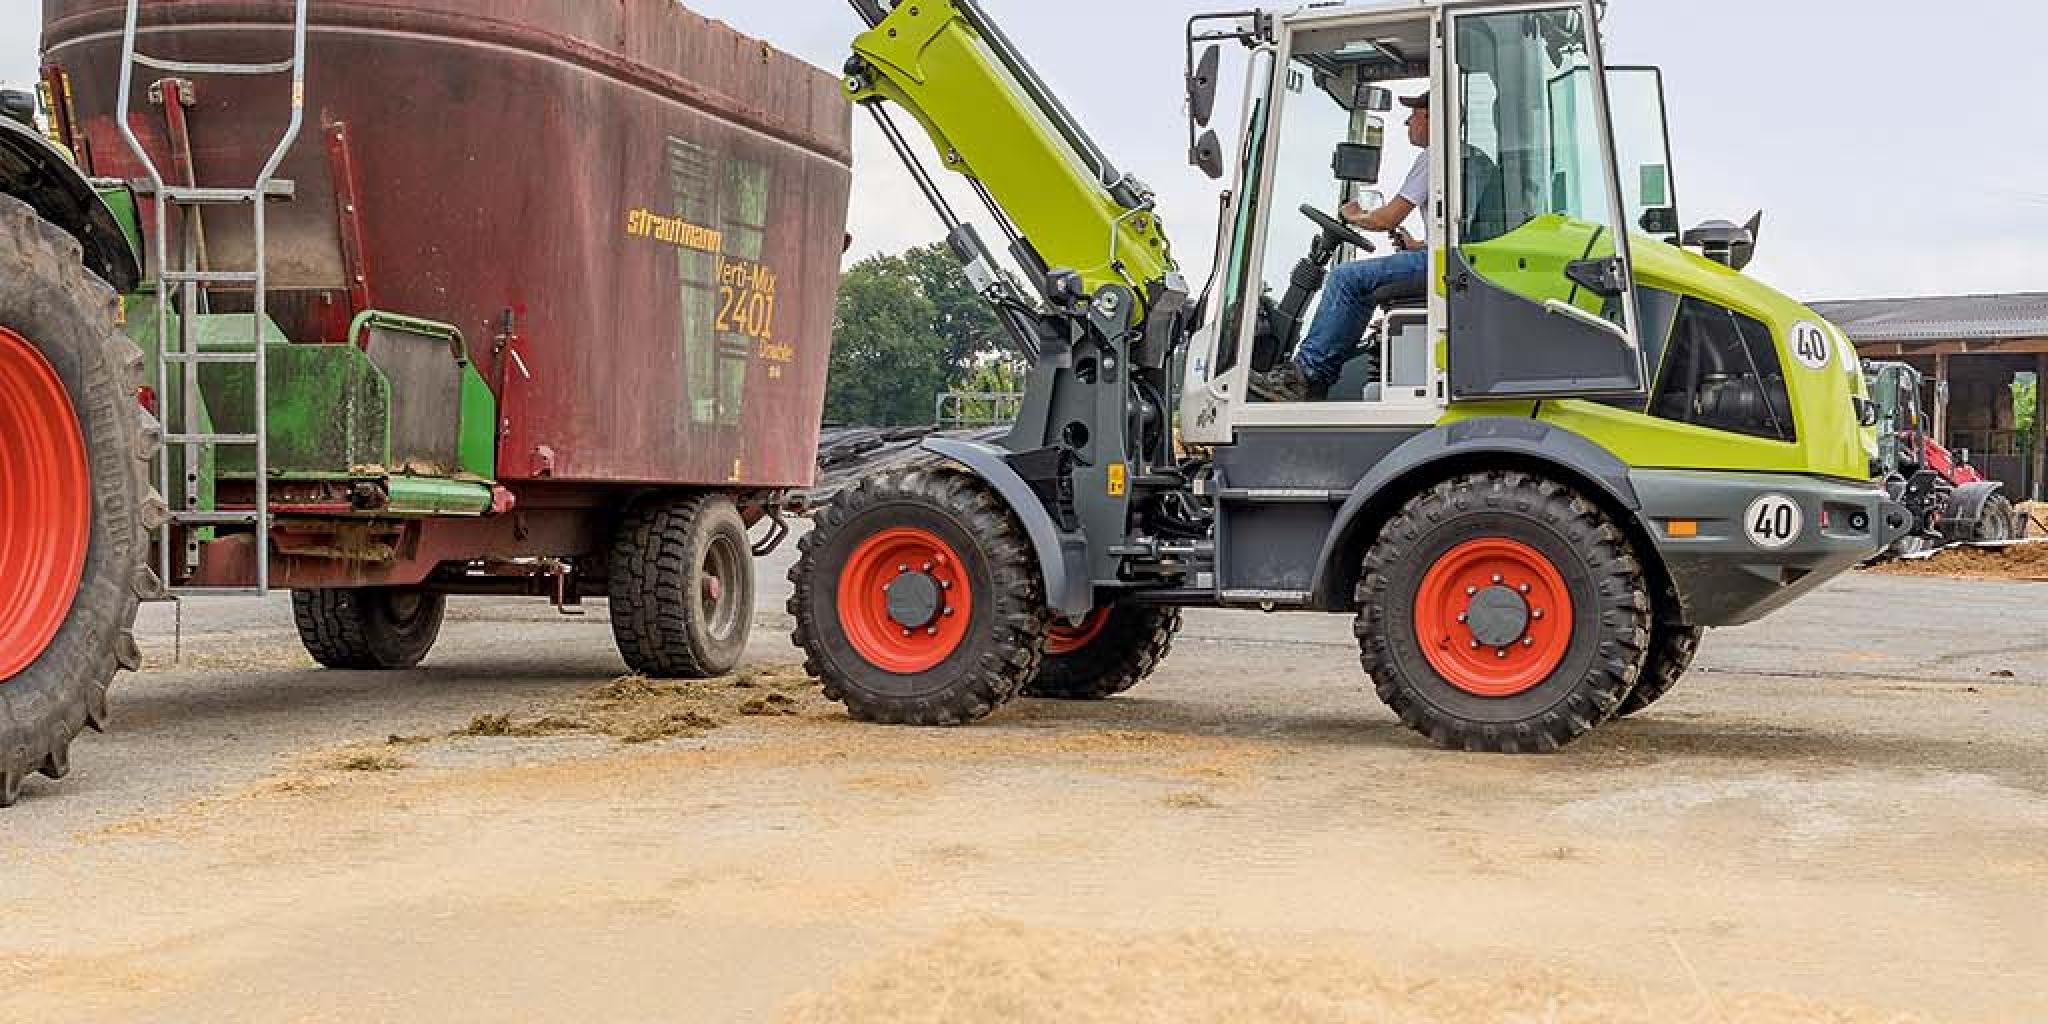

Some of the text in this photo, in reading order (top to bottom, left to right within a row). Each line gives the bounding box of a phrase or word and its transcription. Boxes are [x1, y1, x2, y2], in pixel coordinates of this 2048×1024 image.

[627, 207, 721, 252] strautmann
[715, 254, 777, 295] Verti-Mix
[715, 286, 775, 339] 2401
[1797, 327, 1825, 361] 40
[1754, 503, 1792, 539] 40
